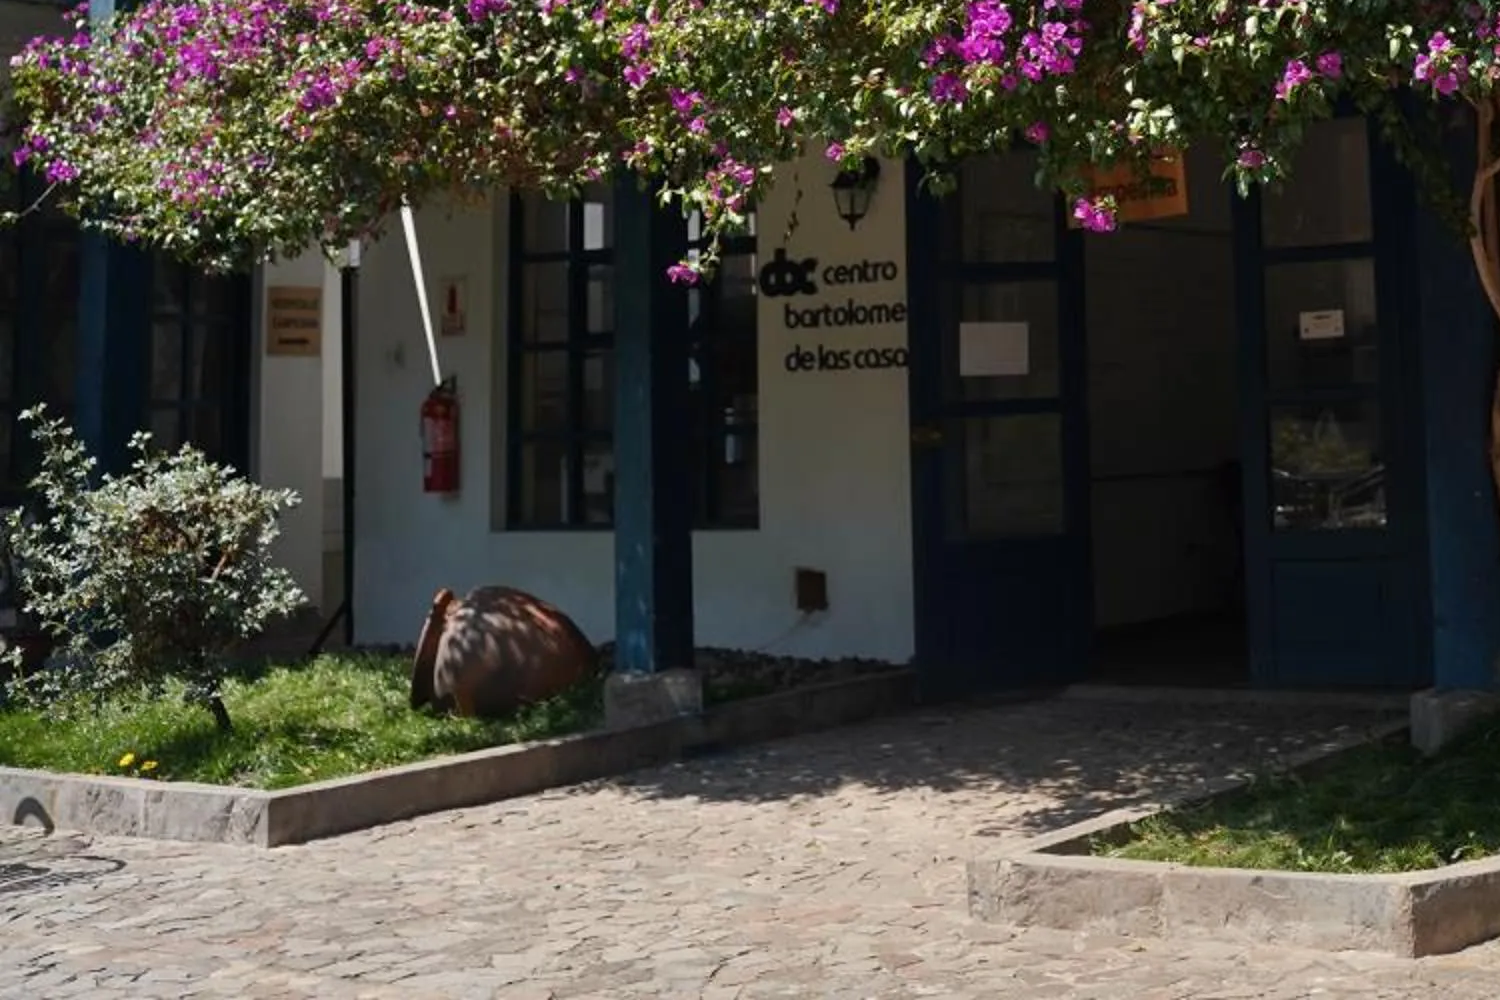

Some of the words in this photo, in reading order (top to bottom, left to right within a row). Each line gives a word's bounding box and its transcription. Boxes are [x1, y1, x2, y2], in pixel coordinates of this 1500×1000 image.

[823, 259, 897, 285] centro
[785, 299, 906, 328] bartolome
[785, 345, 815, 371] de
[819, 344, 851, 370] las
